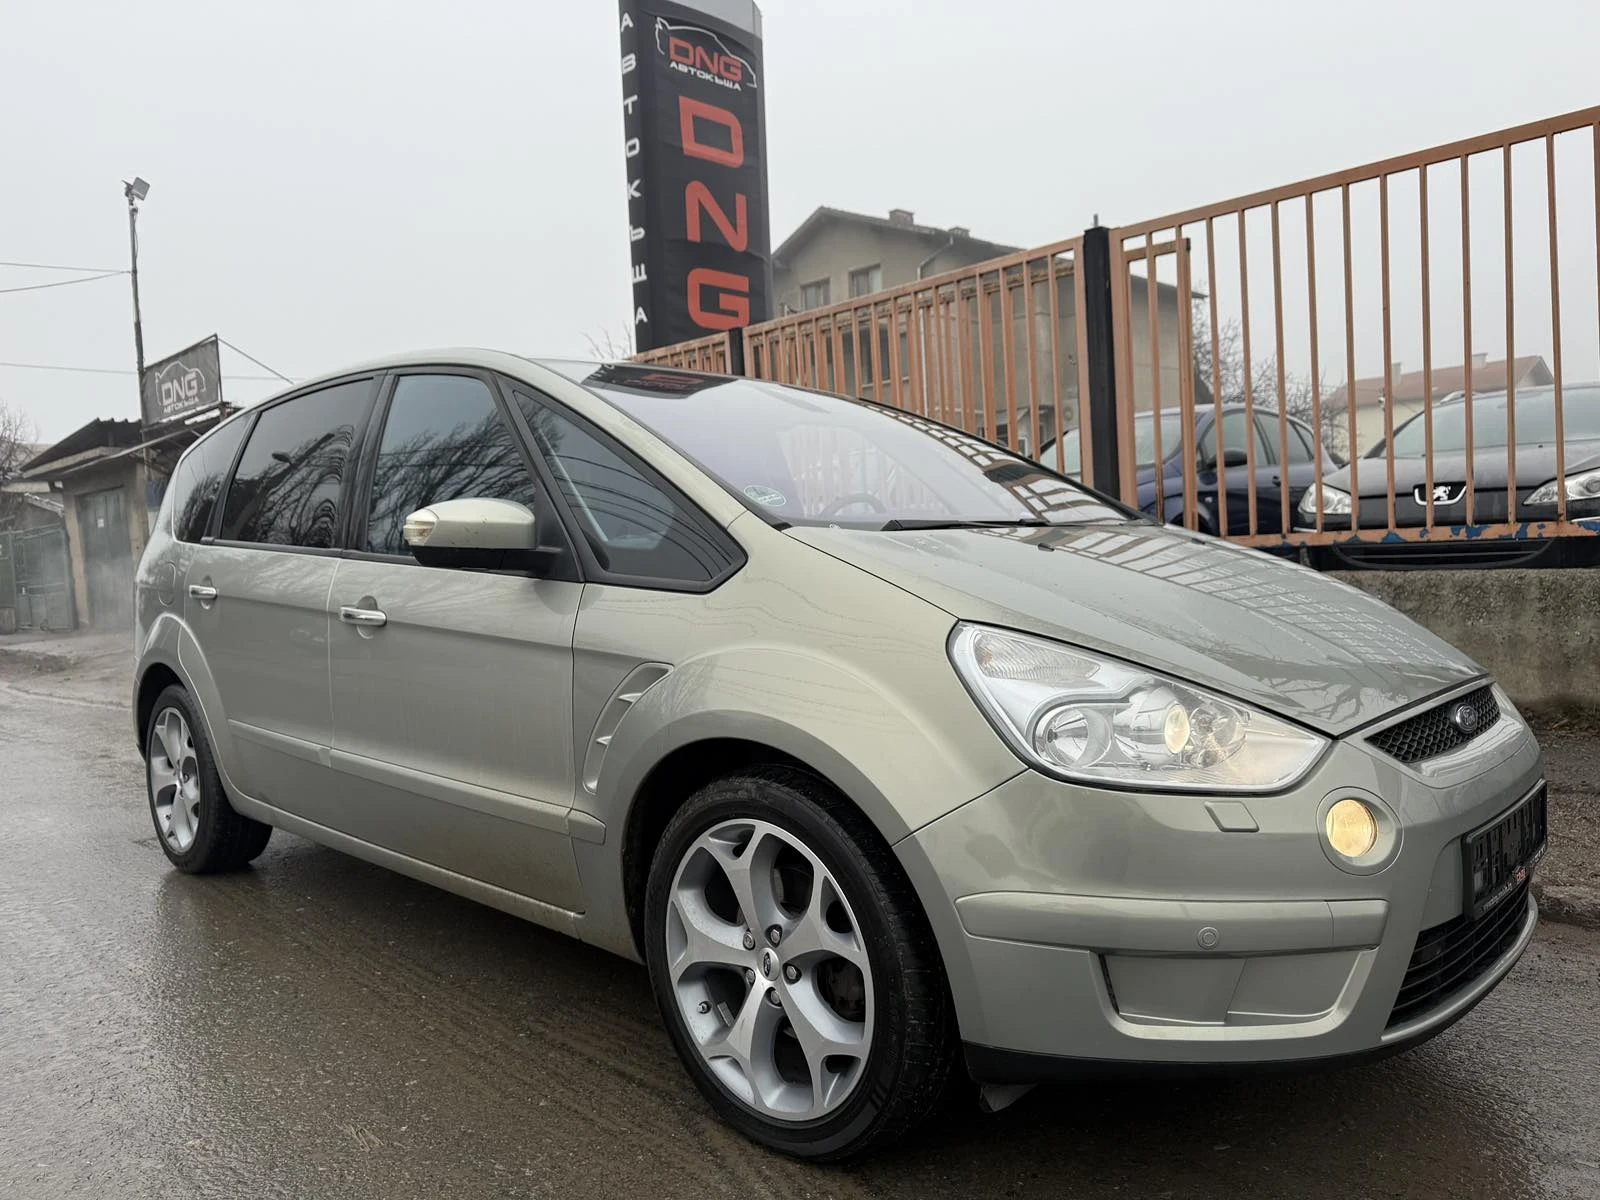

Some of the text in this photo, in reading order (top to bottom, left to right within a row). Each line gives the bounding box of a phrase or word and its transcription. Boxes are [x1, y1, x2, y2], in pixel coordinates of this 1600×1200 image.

[668, 35, 743, 82] DNG
[678, 95, 750, 331] DNG
[161, 371, 198, 406] DNG
